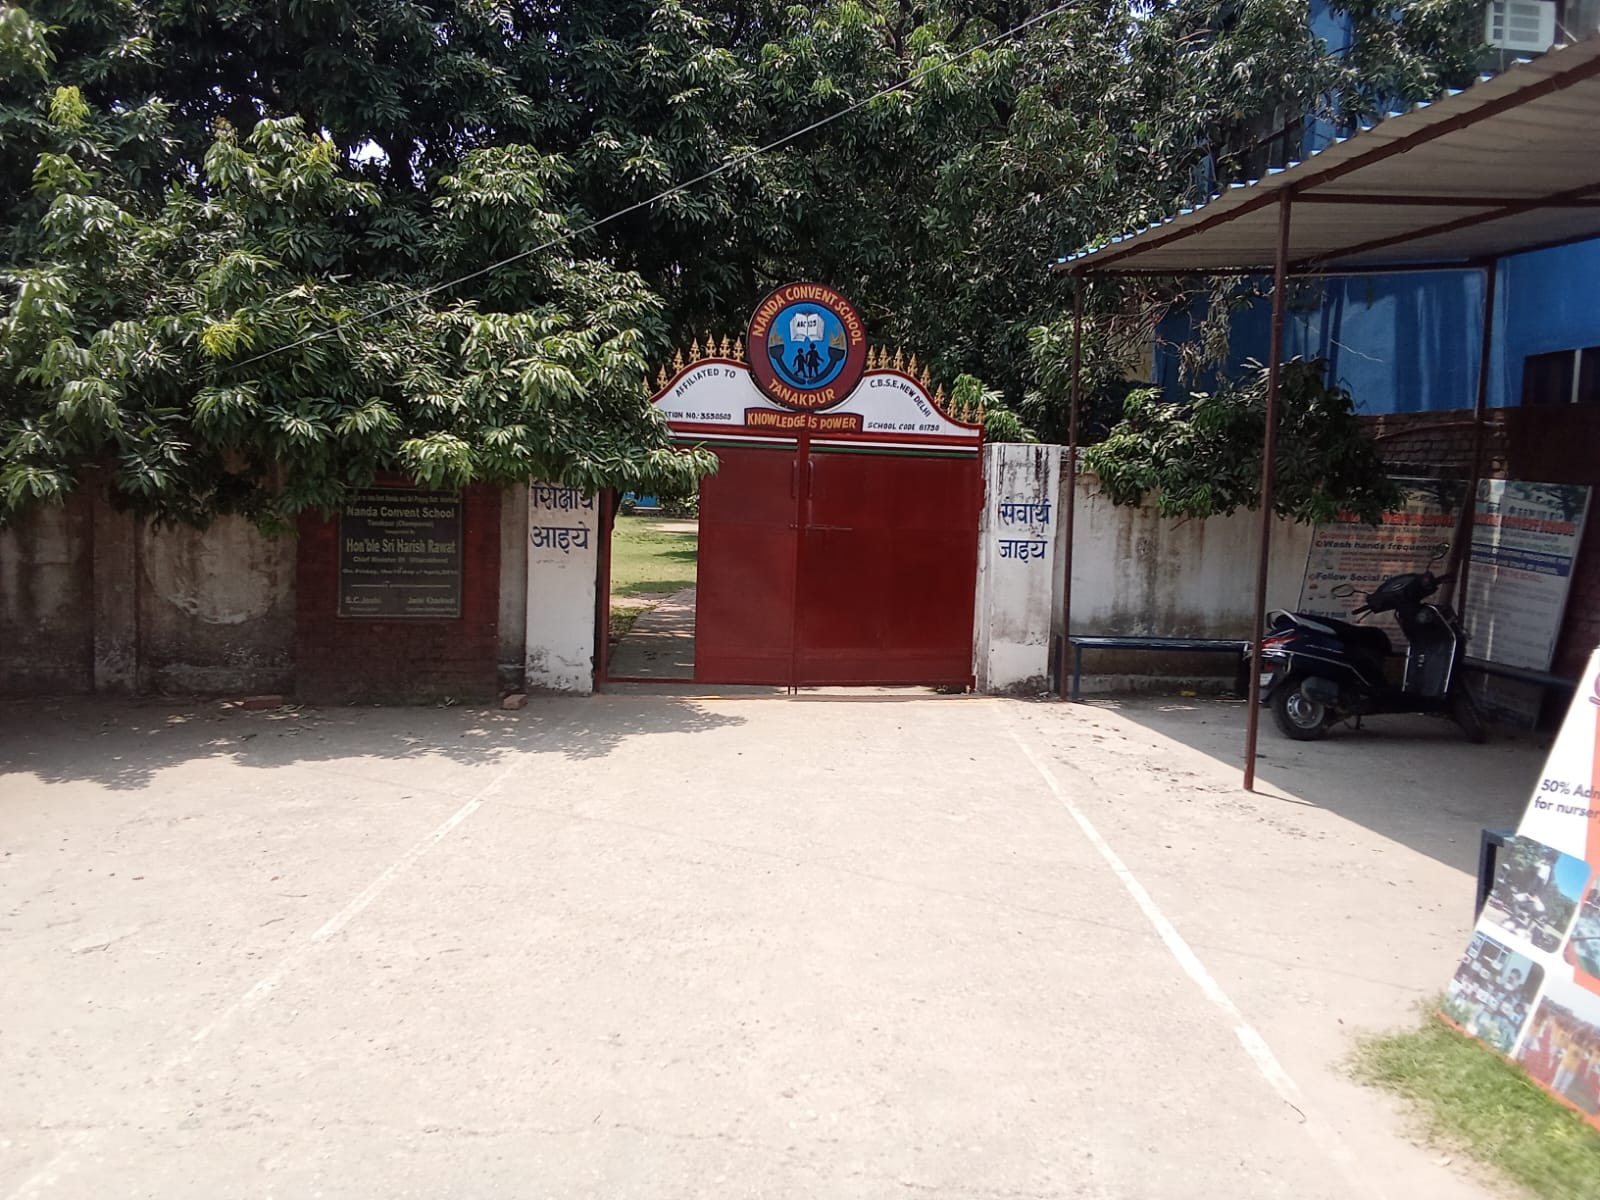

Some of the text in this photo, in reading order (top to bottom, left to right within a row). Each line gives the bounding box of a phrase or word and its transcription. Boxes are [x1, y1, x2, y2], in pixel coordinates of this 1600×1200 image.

[752, 285, 863, 346] NANDA CONVENT SCHOOL
[675, 368, 737, 397] AFFILIATED TO
[768, 378, 836, 406] TANAKPUR
[899, 383, 917, 398] NEW
[913, 395, 932, 418] DELHI
[747, 412, 857, 429] KNOWLEDGE IS POWER
[867, 422, 896, 431] SCHOOL
[898, 423, 915, 431] CODE
[346, 505, 455, 519] Nanda Convent School
[381, 538, 395, 552] Sri
[530, 521, 590, 554] आइये
[1323, 540, 1351, 549] Wash
[1354, 541, 1385, 550] hands
[998, 534, 1048, 564] जाइये
[1350, 573, 1380, 582] Social
[1541, 779, 1570, 795] 50%
[1534, 795, 1554, 810] for
